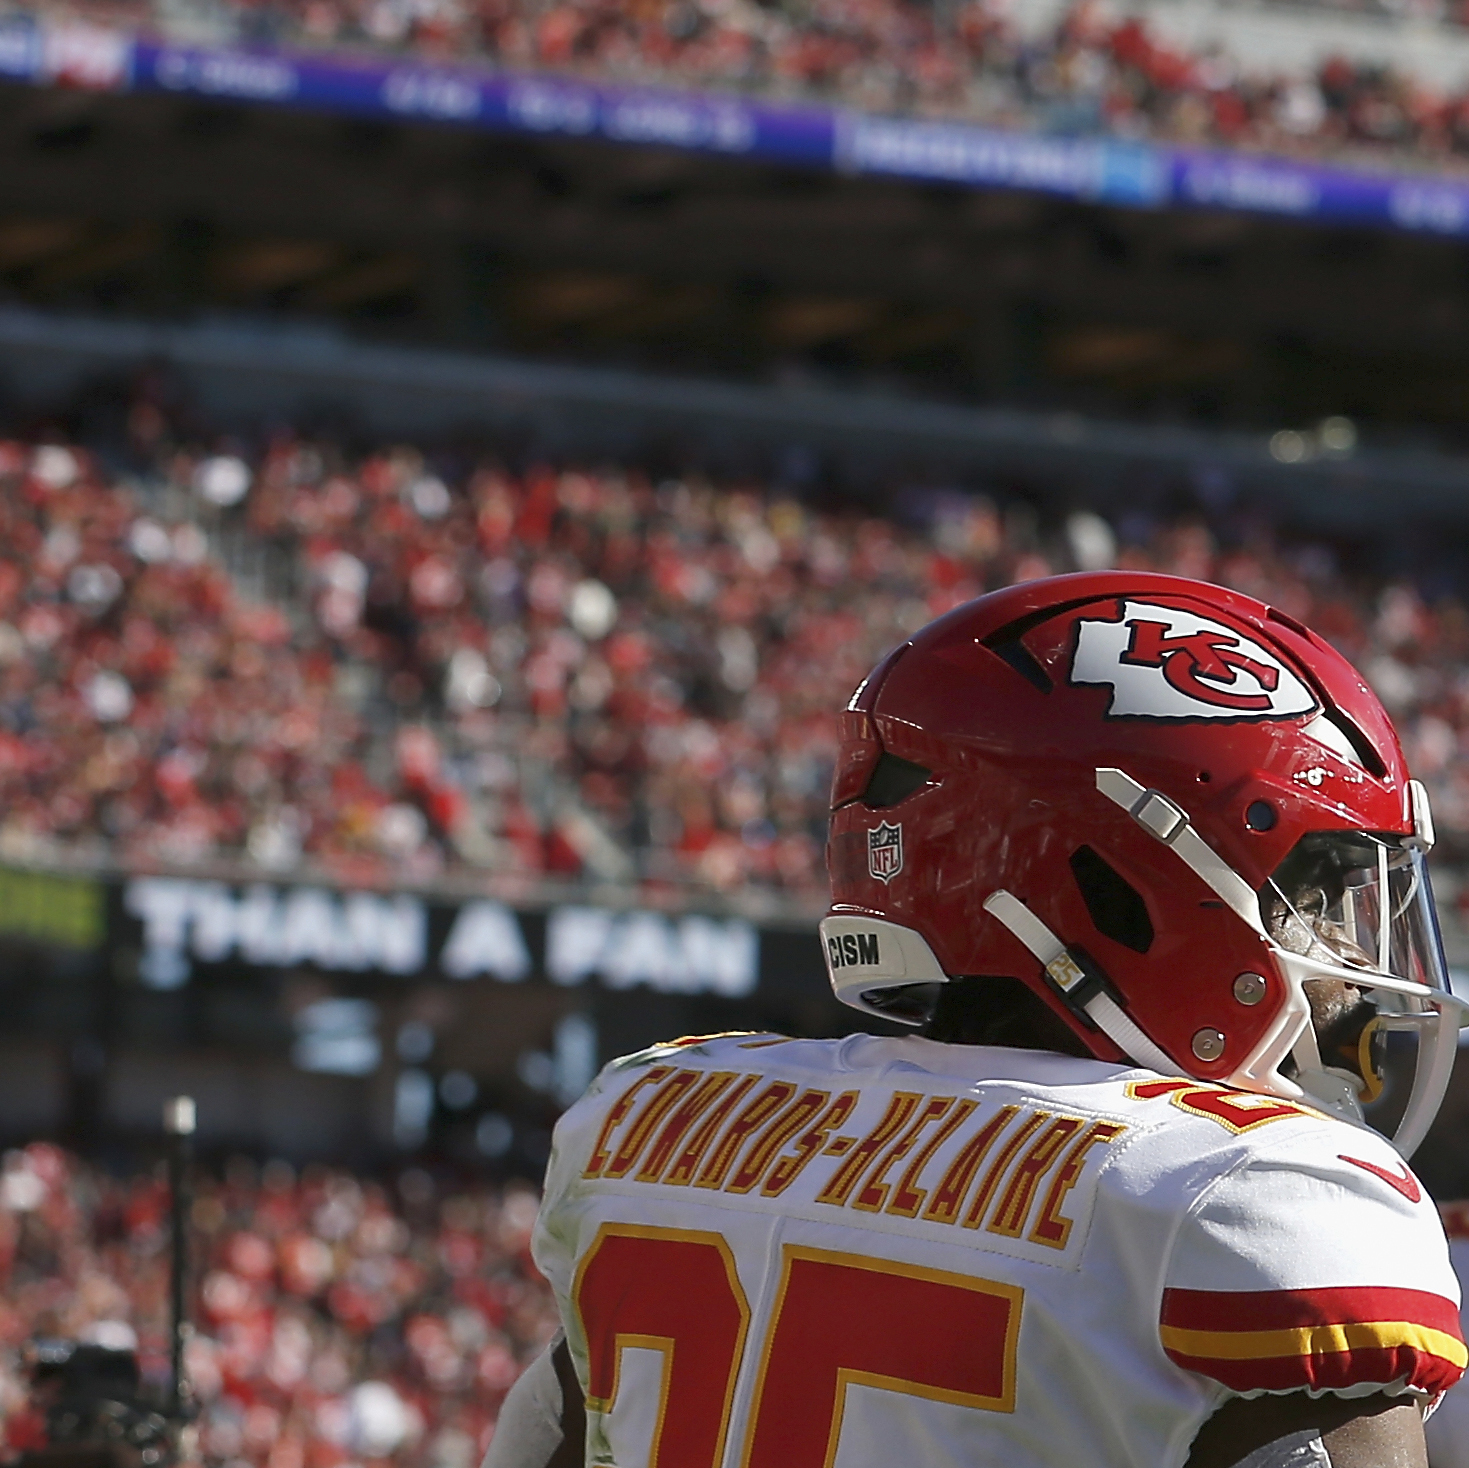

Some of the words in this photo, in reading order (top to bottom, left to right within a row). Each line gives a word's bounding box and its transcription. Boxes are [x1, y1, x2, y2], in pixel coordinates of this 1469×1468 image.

[1119, 619, 1280, 711] KC
[872, 847, 898, 874] NFL
[126, 876, 428, 977] THAN
[441, 901, 532, 982] A
[545, 905, 762, 996] FAN
[583, 1065, 1128, 1250] EDWARDS-HELAIRE
